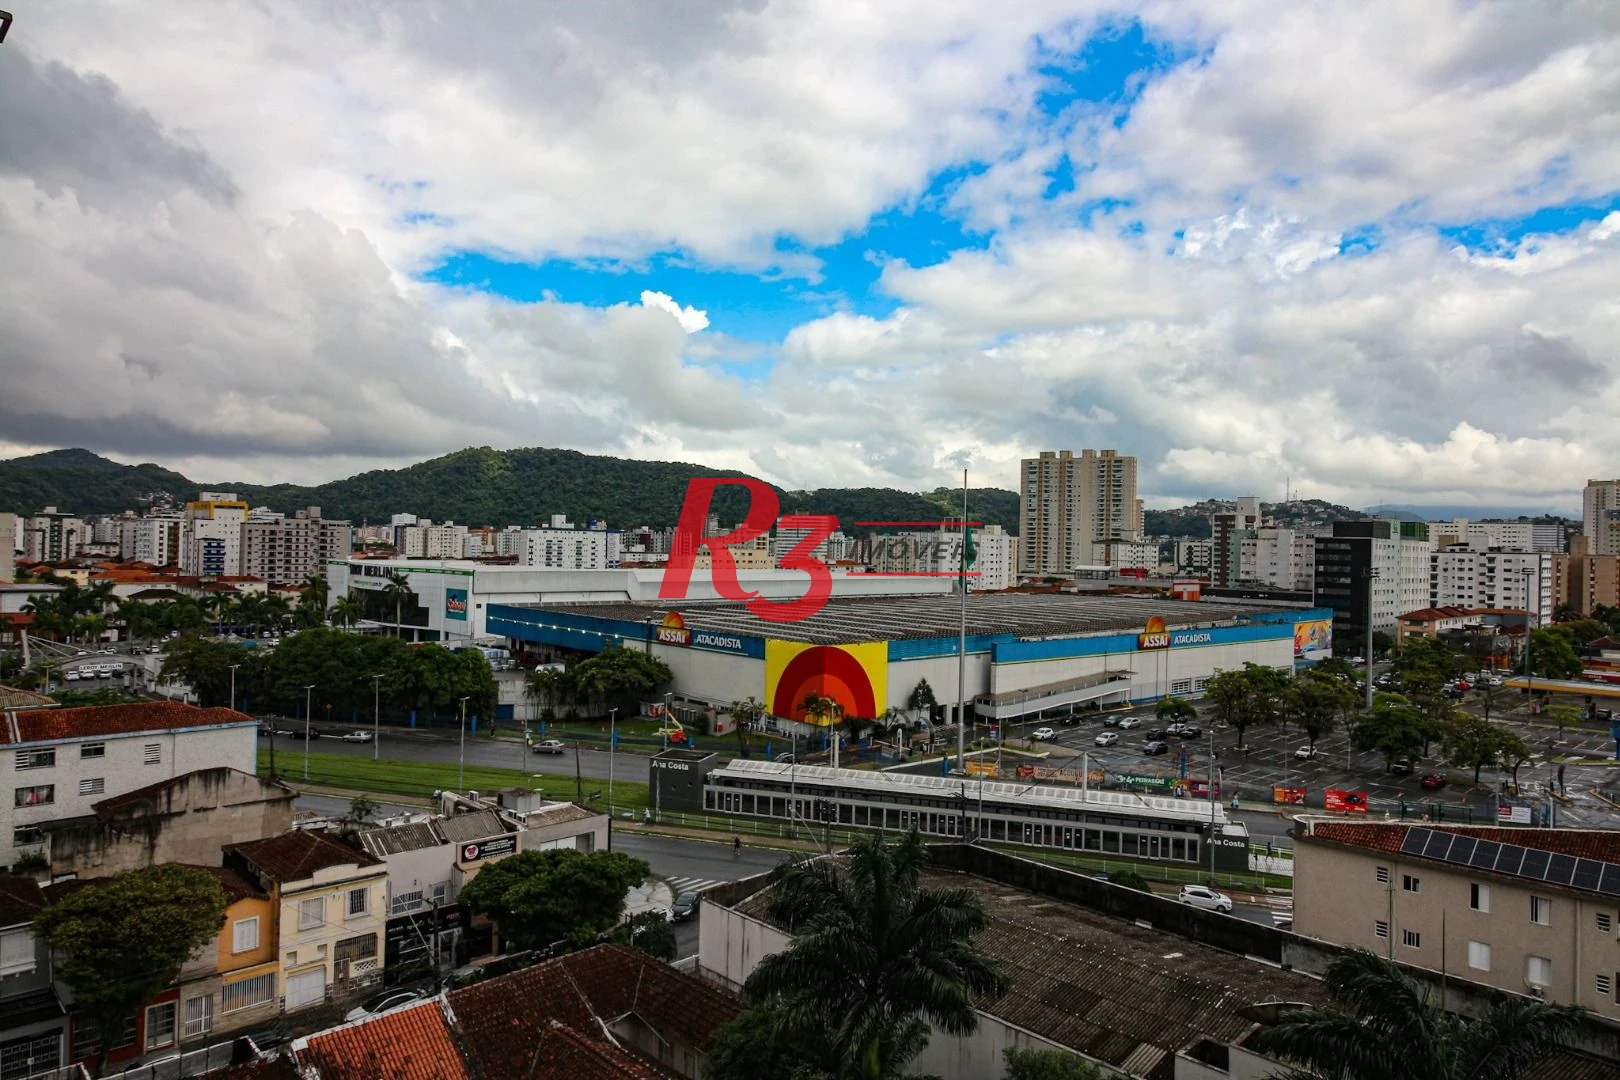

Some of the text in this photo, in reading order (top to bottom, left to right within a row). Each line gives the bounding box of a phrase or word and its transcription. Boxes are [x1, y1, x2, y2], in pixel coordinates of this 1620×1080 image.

[696, 634, 742, 649] ATACADISTA
[1174, 633, 1211, 645] ATACADISTA
[668, 762, 689, 771] Costa
[1223, 840, 1246, 848] Costa
